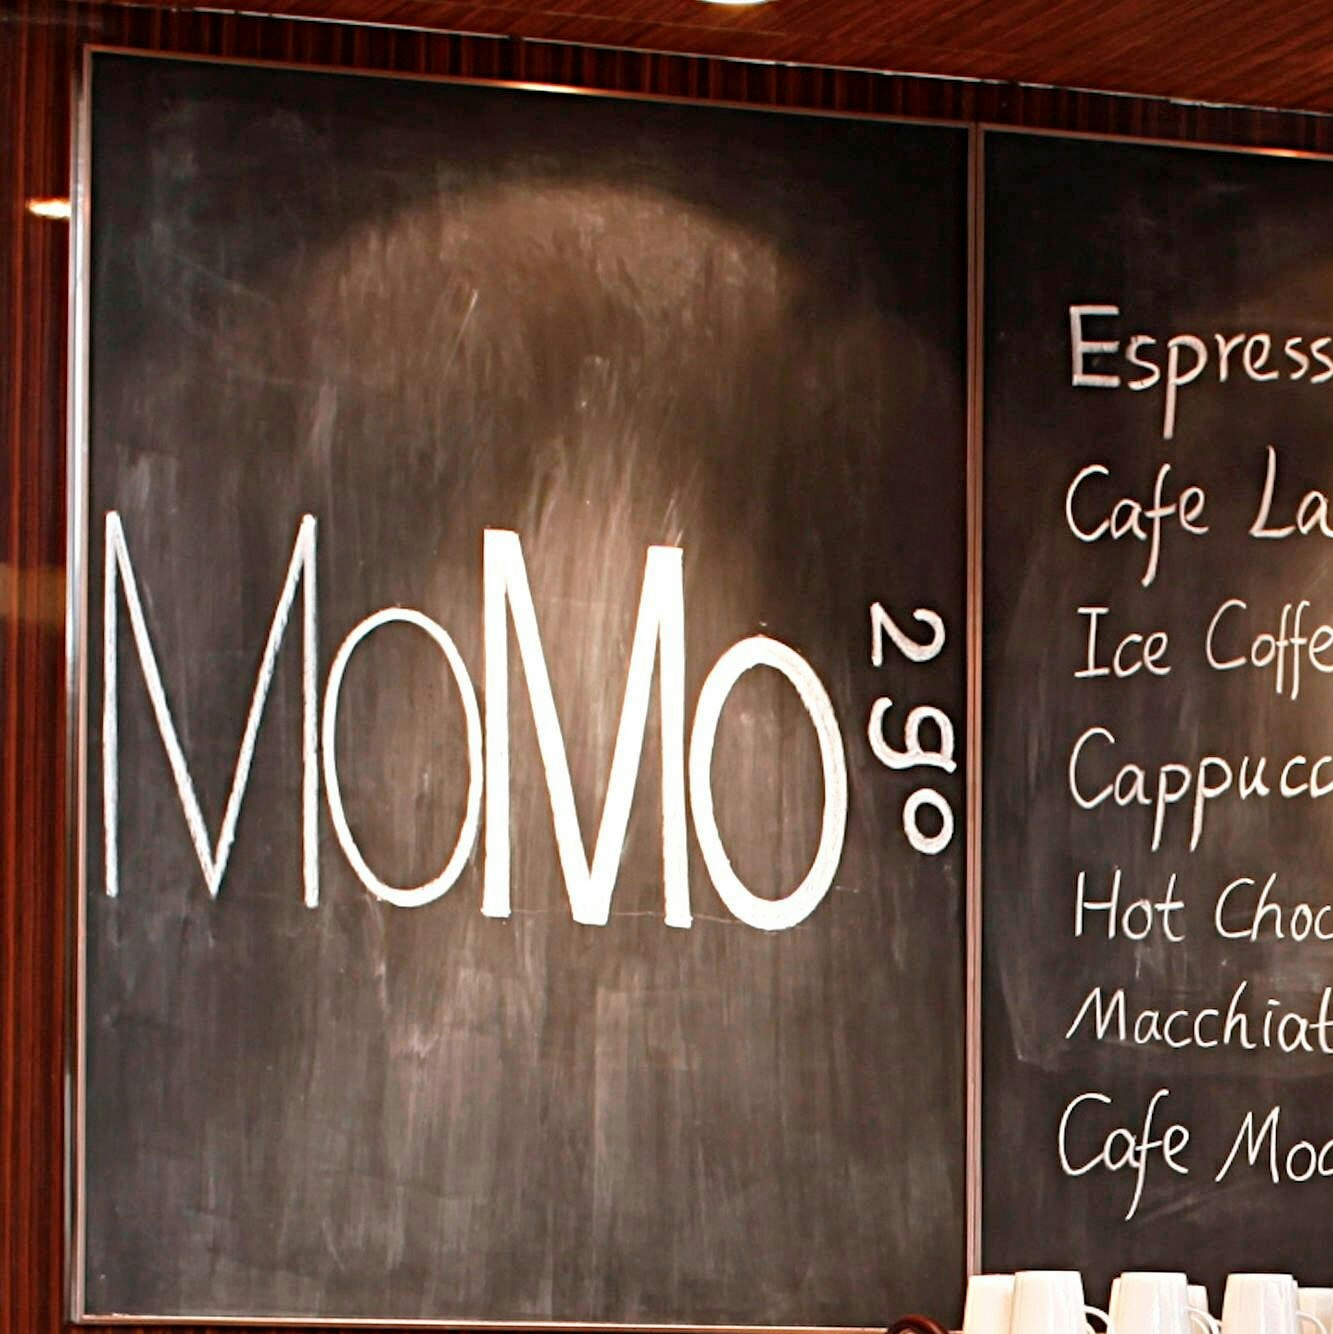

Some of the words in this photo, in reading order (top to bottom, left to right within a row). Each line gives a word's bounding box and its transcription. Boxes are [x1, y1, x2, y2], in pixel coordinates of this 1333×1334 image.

[1065, 464, 1210, 587] Cafe
[1074, 606, 1172, 678] Ice
[104, 510, 848, 932] MoMo
[1074, 869, 1186, 943] Hot
[1058, 1090, 1190, 1220] Cafe
